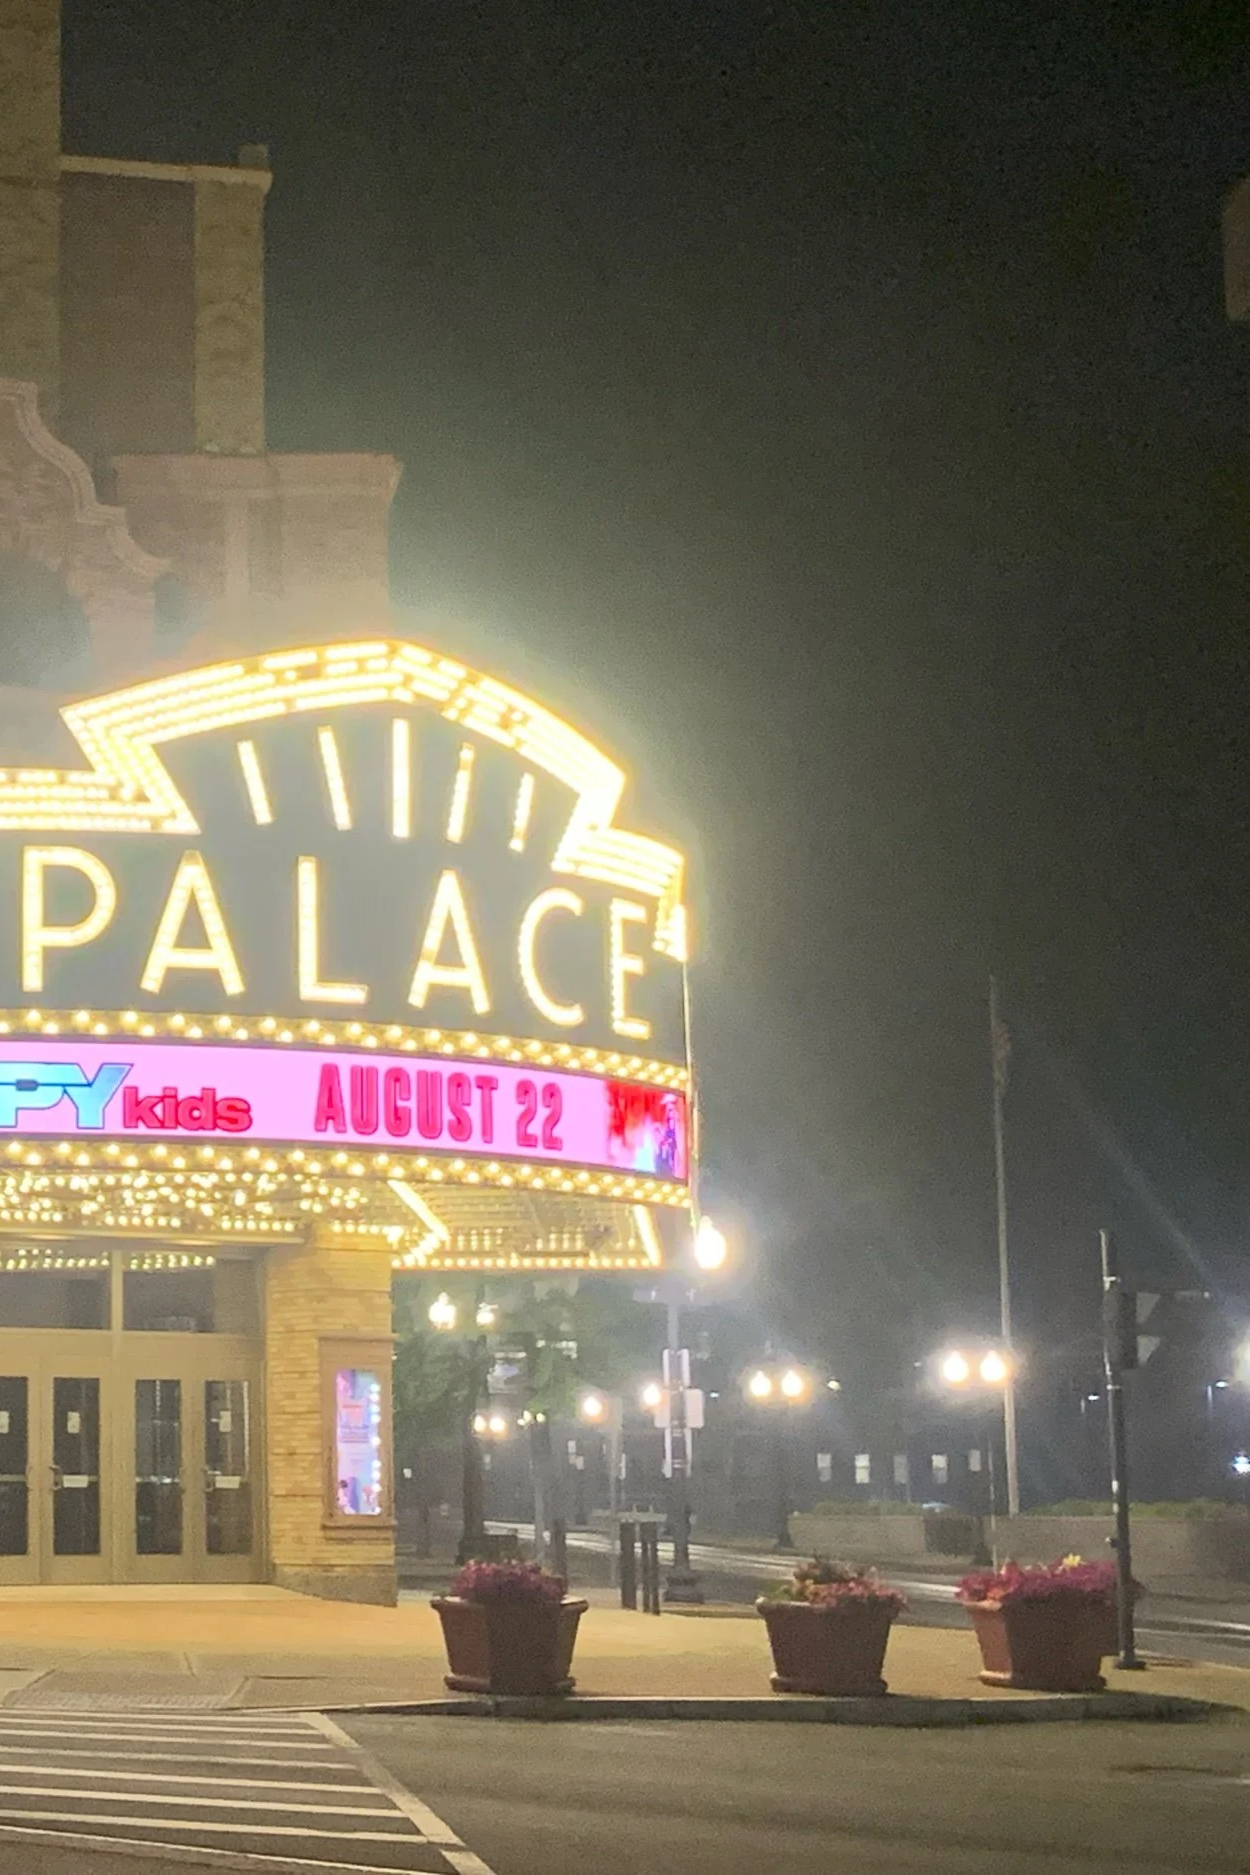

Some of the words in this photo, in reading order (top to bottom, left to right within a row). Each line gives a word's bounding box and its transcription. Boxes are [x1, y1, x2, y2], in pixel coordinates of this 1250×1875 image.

[22, 845, 651, 1039] PALACE
[123, 1086, 253, 1132] kids
[315, 1063, 498, 1144] AUGUST
[516, 1079, 563, 1152] 22
